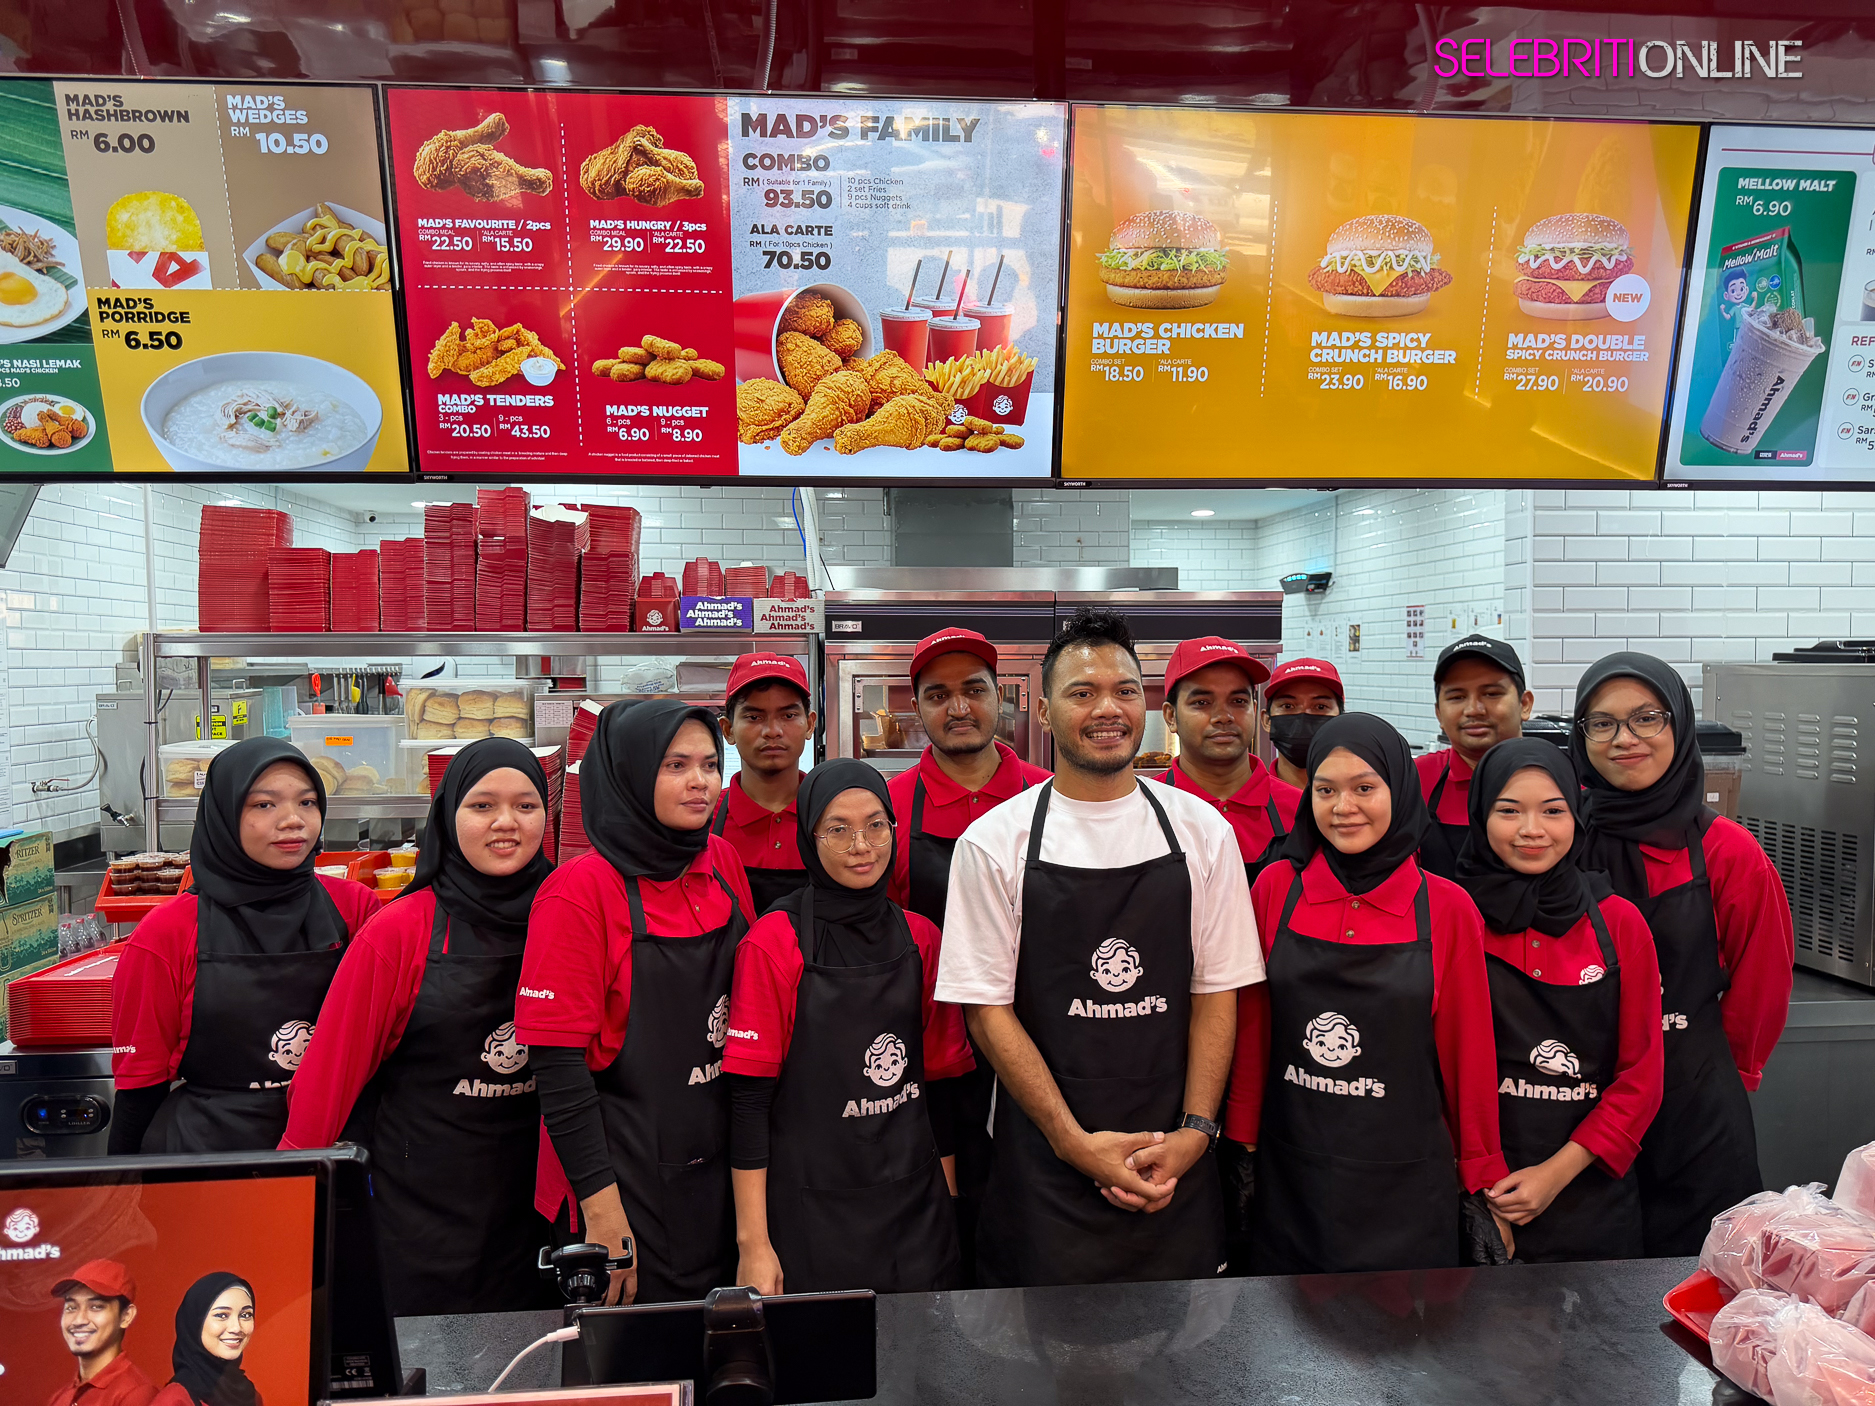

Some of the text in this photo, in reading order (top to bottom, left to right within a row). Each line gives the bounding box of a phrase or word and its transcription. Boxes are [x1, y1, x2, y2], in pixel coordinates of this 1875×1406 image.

[64, 94, 124, 108] MAD'S
[227, 95, 285, 110] MAD'S
[67, 108, 190, 124] HASHBROWN
[228, 110, 308, 124] WEDGES
[741, 112, 981, 143] MAD'S FAMILY
[70, 129, 156, 154] RM 6.00
[231, 126, 328, 154] RM 10.50
[742, 153, 831, 172] COMBO
[743, 178, 760, 187] RM
[1737, 177, 1836, 192] MELLOW MALT
[764, 188, 833, 209] 93.50
[870, 194, 903, 202] Nuggets
[892, 202, 911, 210] drink
[1736, 196, 1792, 216] RM 6.90
[418, 218, 551, 231] MAD'S FAVOURITE 2pcs
[590, 220, 707, 232] MAD'S HUNGRY 3pcs
[750, 224, 833, 236] ALA CARTE
[432, 236, 473, 251] 22.50
[494, 238, 533, 252] 15.50
[604, 238, 644, 251] 29.90
[665, 240, 705, 253] 22.50
[782, 241, 800, 249] 10pcs
[1754, 244, 1779, 262] Malt
[762, 251, 832, 270] 70.50
[96, 298, 154, 310] MAD'S
[1613, 293, 1643, 304] NEW
[98, 311, 191, 325] PORRIDGE
[1092, 322, 1244, 339] MAD'S CHICKEN
[102, 329, 183, 351] RM 6.50
[1092, 338, 1171, 354] BURGER
[1311, 332, 1432, 348] MAD'S SPICY
[1508, 333, 1645, 350] MAD'S DOUBLE
[1310, 349, 1456, 364] CRUNCH BURGER
[1506, 350, 1649, 362] SPICY CRUNCH BURGER
[13, 360, 40, 368] NASI
[42, 360, 81, 368] LEMAK
[1104, 366, 1144, 382] 18.50
[1171, 366, 1209, 382] 11.90
[1308, 373, 1364, 390] RM 23.90
[1375, 374, 1428, 391] RM 16.90
[1504, 373, 1559, 391] RM 27.90
[1571, 374, 1628, 392] RM 20.90
[438, 394, 554, 407] MAD'S TENDERS
[438, 405, 476, 413] COMBO
[606, 405, 709, 418] MAD'S NUGGET
[1740, 375, 1786, 443] Ahmad's
[661, 418, 666, 426] 9
[452, 424, 491, 437] 20.50
[512, 425, 550, 438] 43.50
[619, 428, 649, 441] 6.90
[673, 429, 703, 442] 8.90
[696, 602, 742, 610] Ahmad's
[769, 605, 815, 614] Ahmad's
[686, 610, 734, 618] Ahmad's
[761, 614, 806, 622] Ahmad's
[695, 618, 742, 627] Ahmad's
[769, 622, 815, 630] Ahmad's
[1200, 645, 1239, 655] Ahmad's
[1453, 641, 1492, 652] Ahmad's
[751, 660, 790, 668] Ahmad's
[1284, 665, 1322, 674] Ahmad's
[1068, 995, 1168, 1018] Ahmad's
[1284, 1064, 1385, 1098] Ahmad's
[1498, 1077, 1598, 1101] Ahmad's
[842, 1080, 920, 1119] Ahmad's
